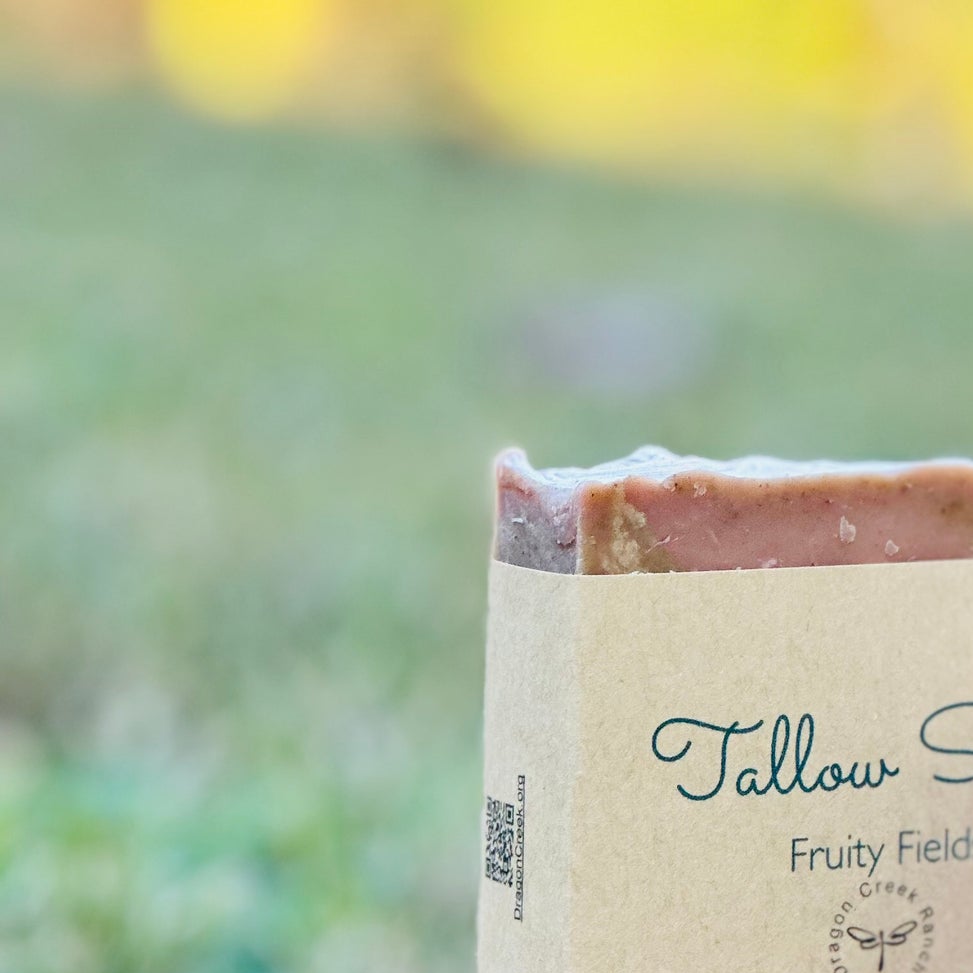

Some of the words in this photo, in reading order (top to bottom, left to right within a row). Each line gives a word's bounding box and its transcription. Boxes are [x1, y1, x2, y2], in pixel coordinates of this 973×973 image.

[652, 714, 899, 801] Tallow
[514, 775, 525, 921] DragonCreek.org
[791, 835, 884, 877] Fruity
[859, 882, 918, 903] Creek
